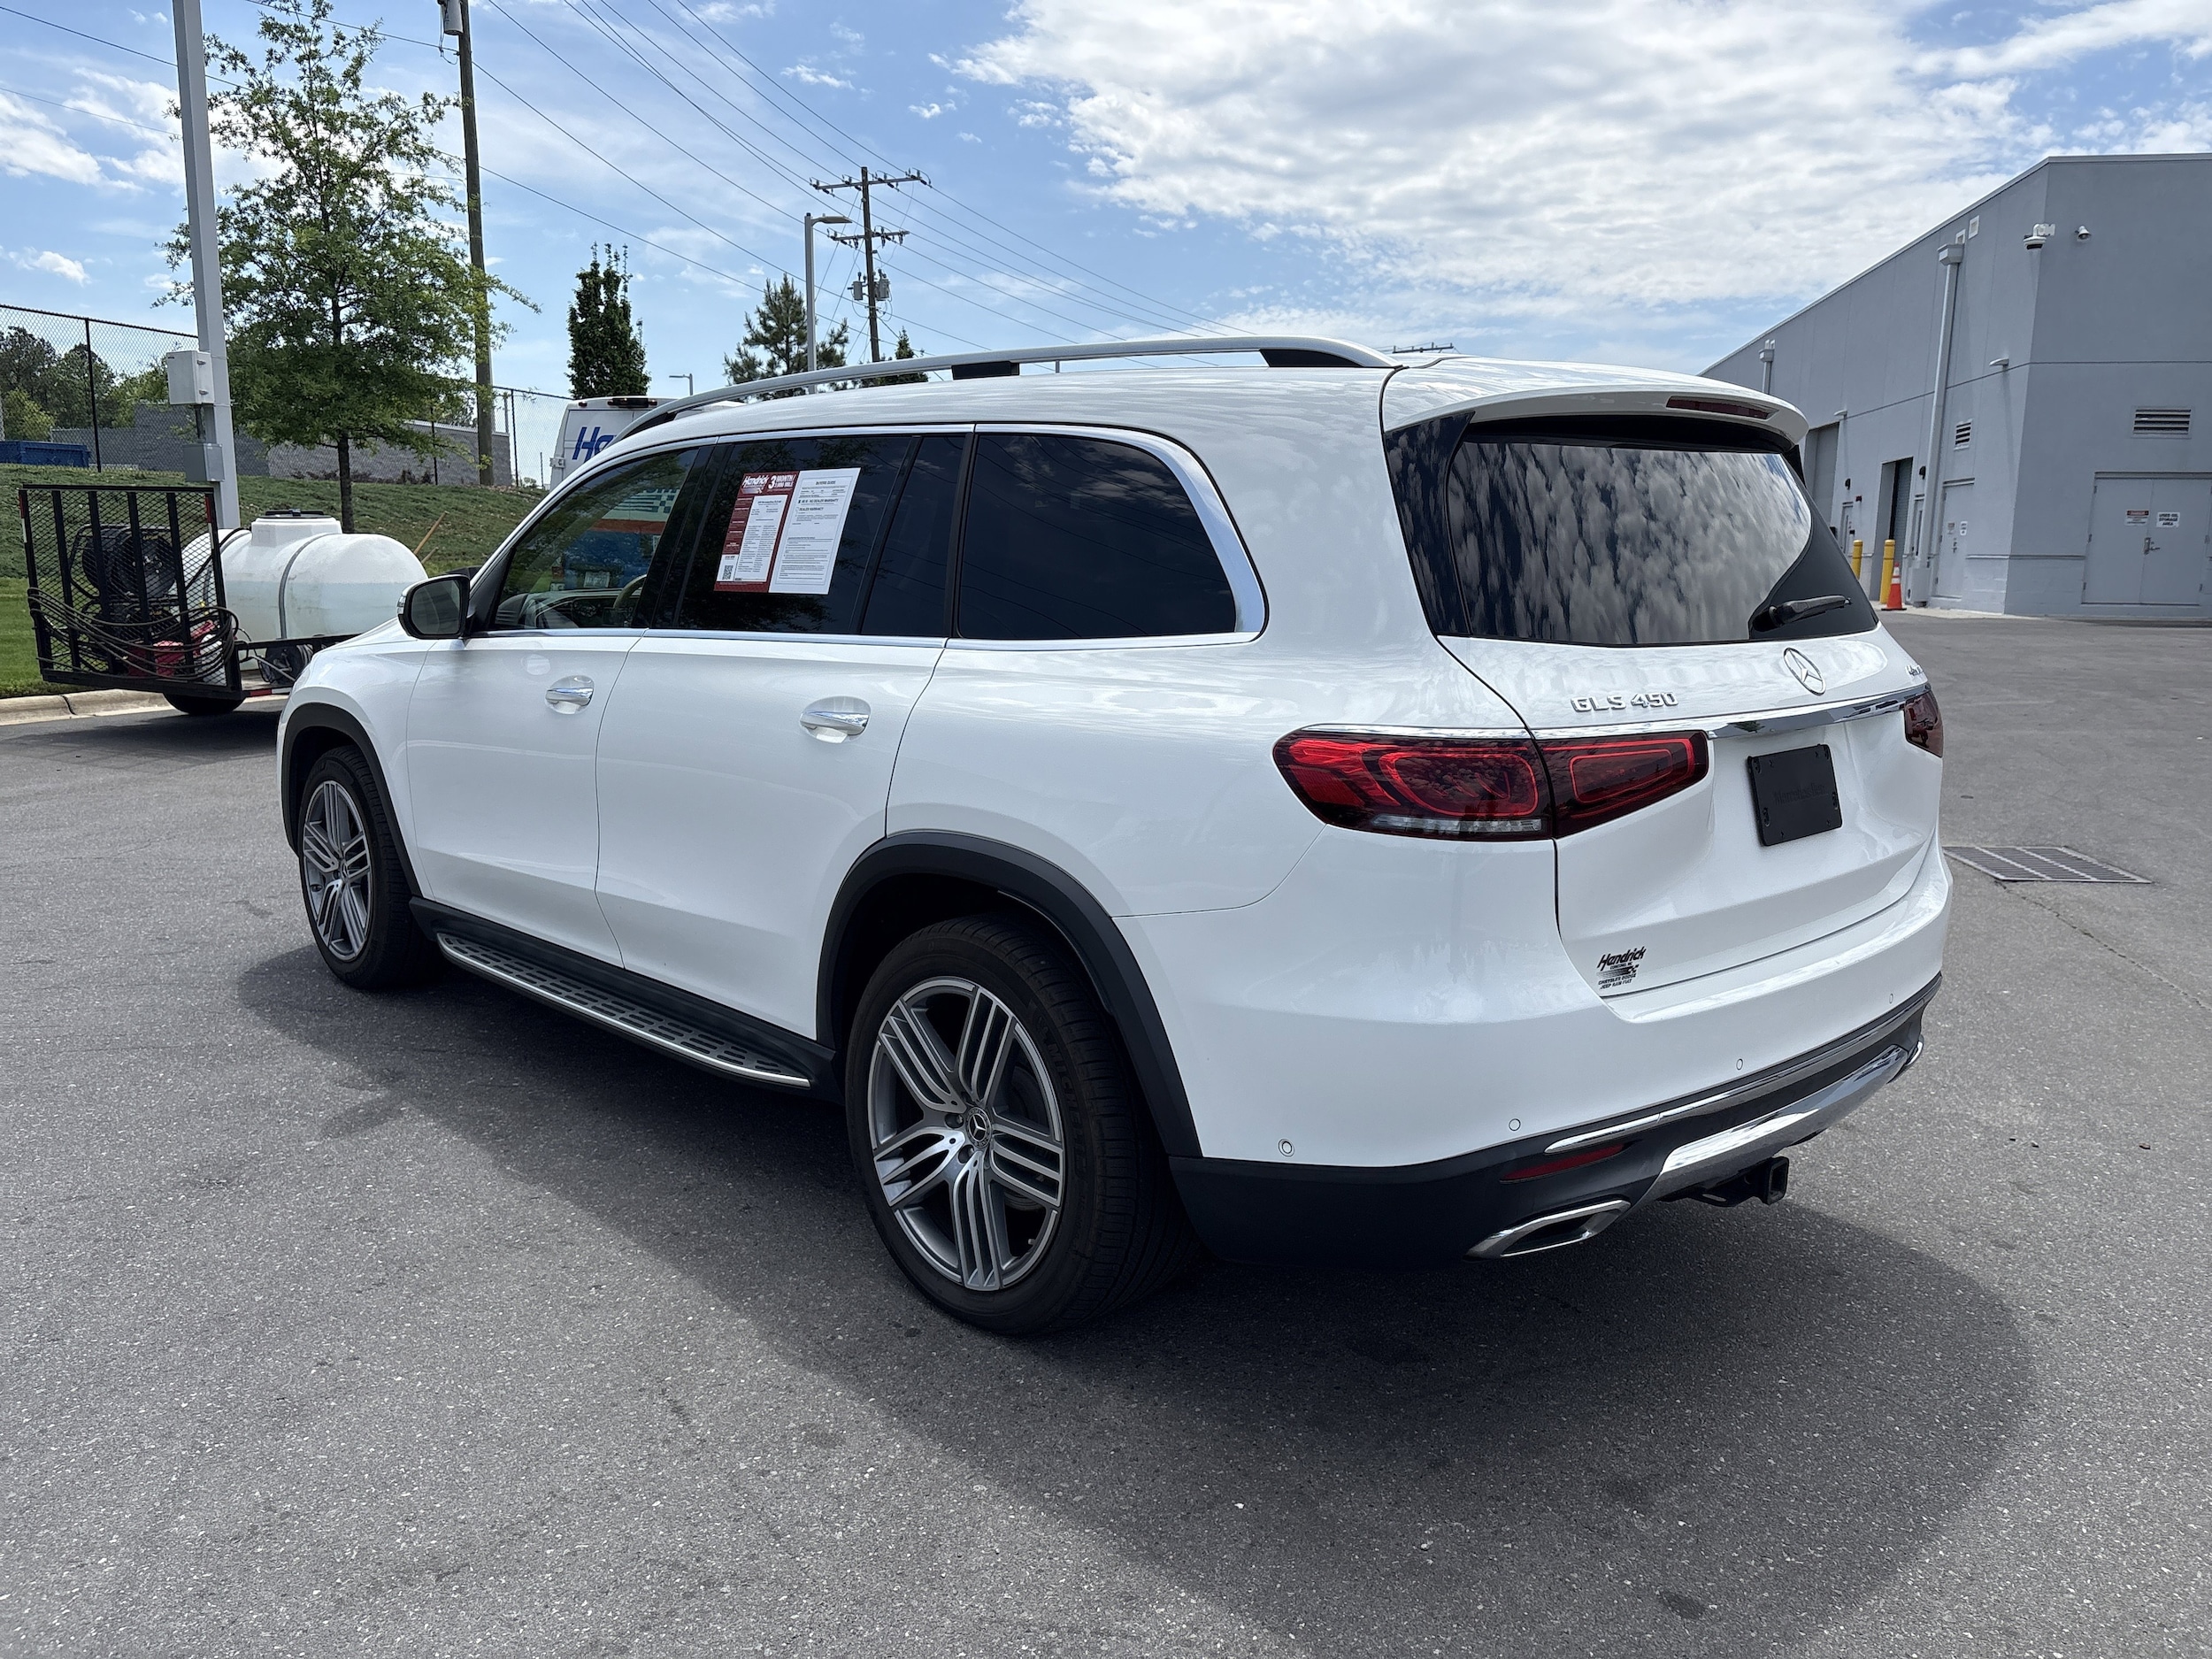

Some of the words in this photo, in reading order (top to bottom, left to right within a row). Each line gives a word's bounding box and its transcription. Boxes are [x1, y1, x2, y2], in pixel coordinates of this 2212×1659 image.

[768, 475, 776, 488] 3
[1571, 695, 1626, 712] GLS
[1631, 691, 1678, 709] 450
[1597, 946, 1647, 971] Hendrick
[1598, 976, 1621, 985] CHRYSLER
